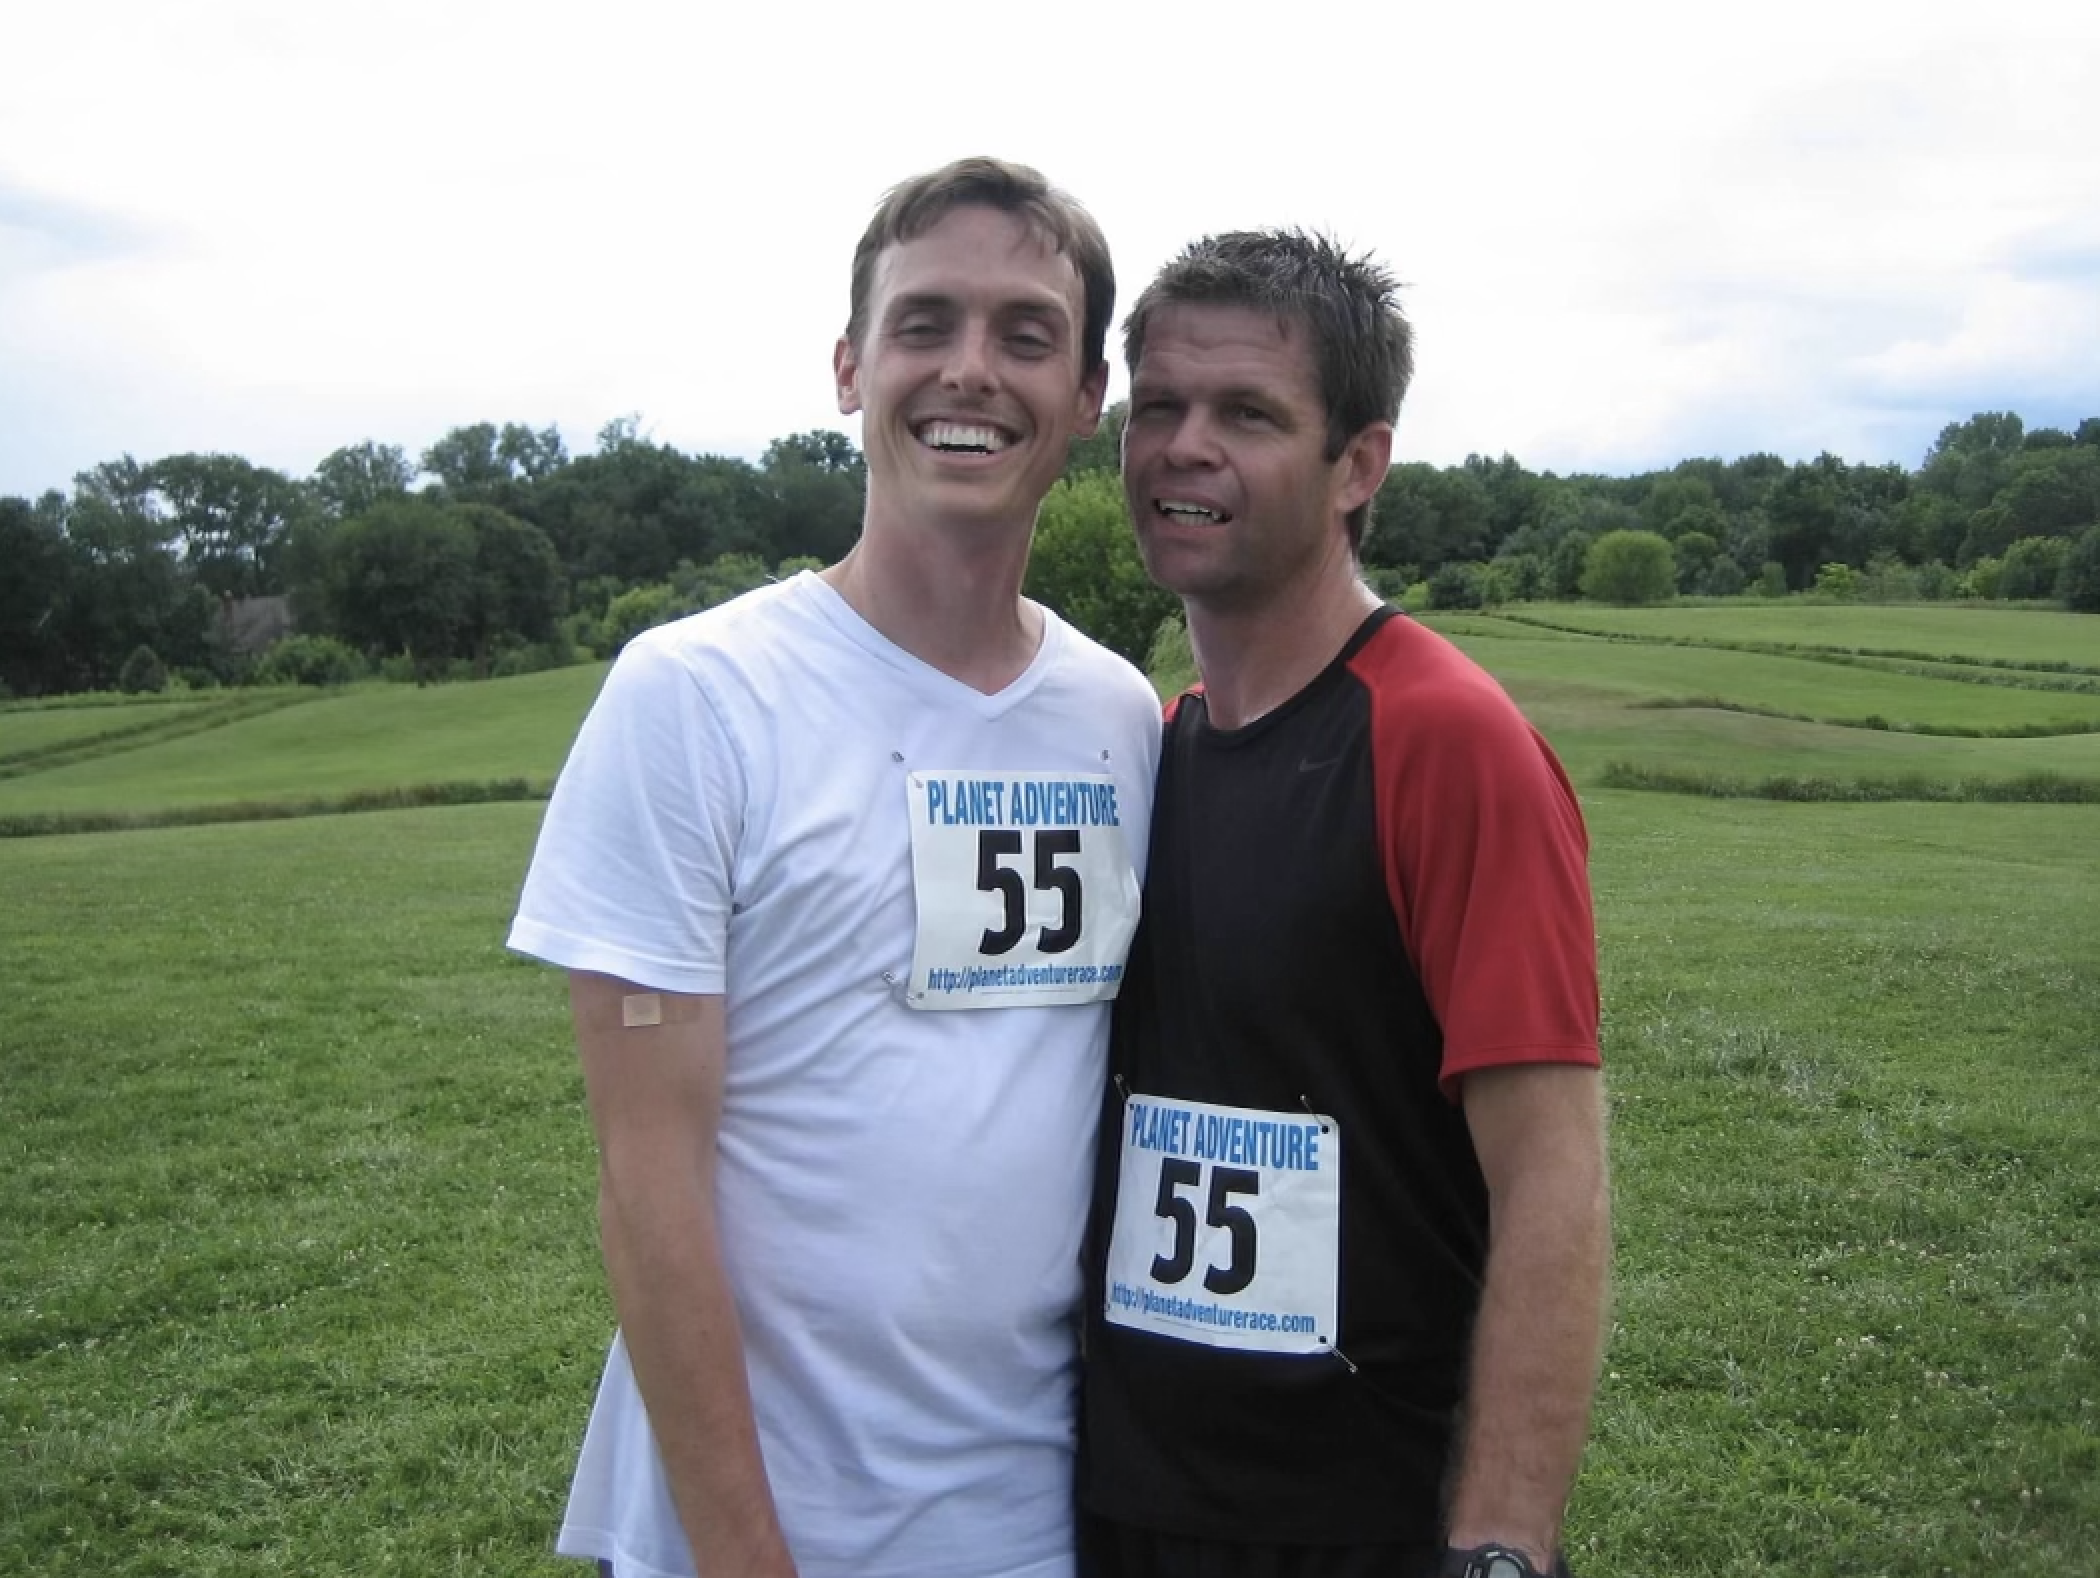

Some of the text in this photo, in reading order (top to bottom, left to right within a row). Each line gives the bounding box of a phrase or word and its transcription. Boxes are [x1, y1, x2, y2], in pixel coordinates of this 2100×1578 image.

[927, 779, 1120, 826] PLANET ADVENTURE
[977, 829, 1082, 955] 55
[1131, 1103, 1319, 1171] PLANET ADVENTURE
[1150, 1157, 1259, 1294] 55
